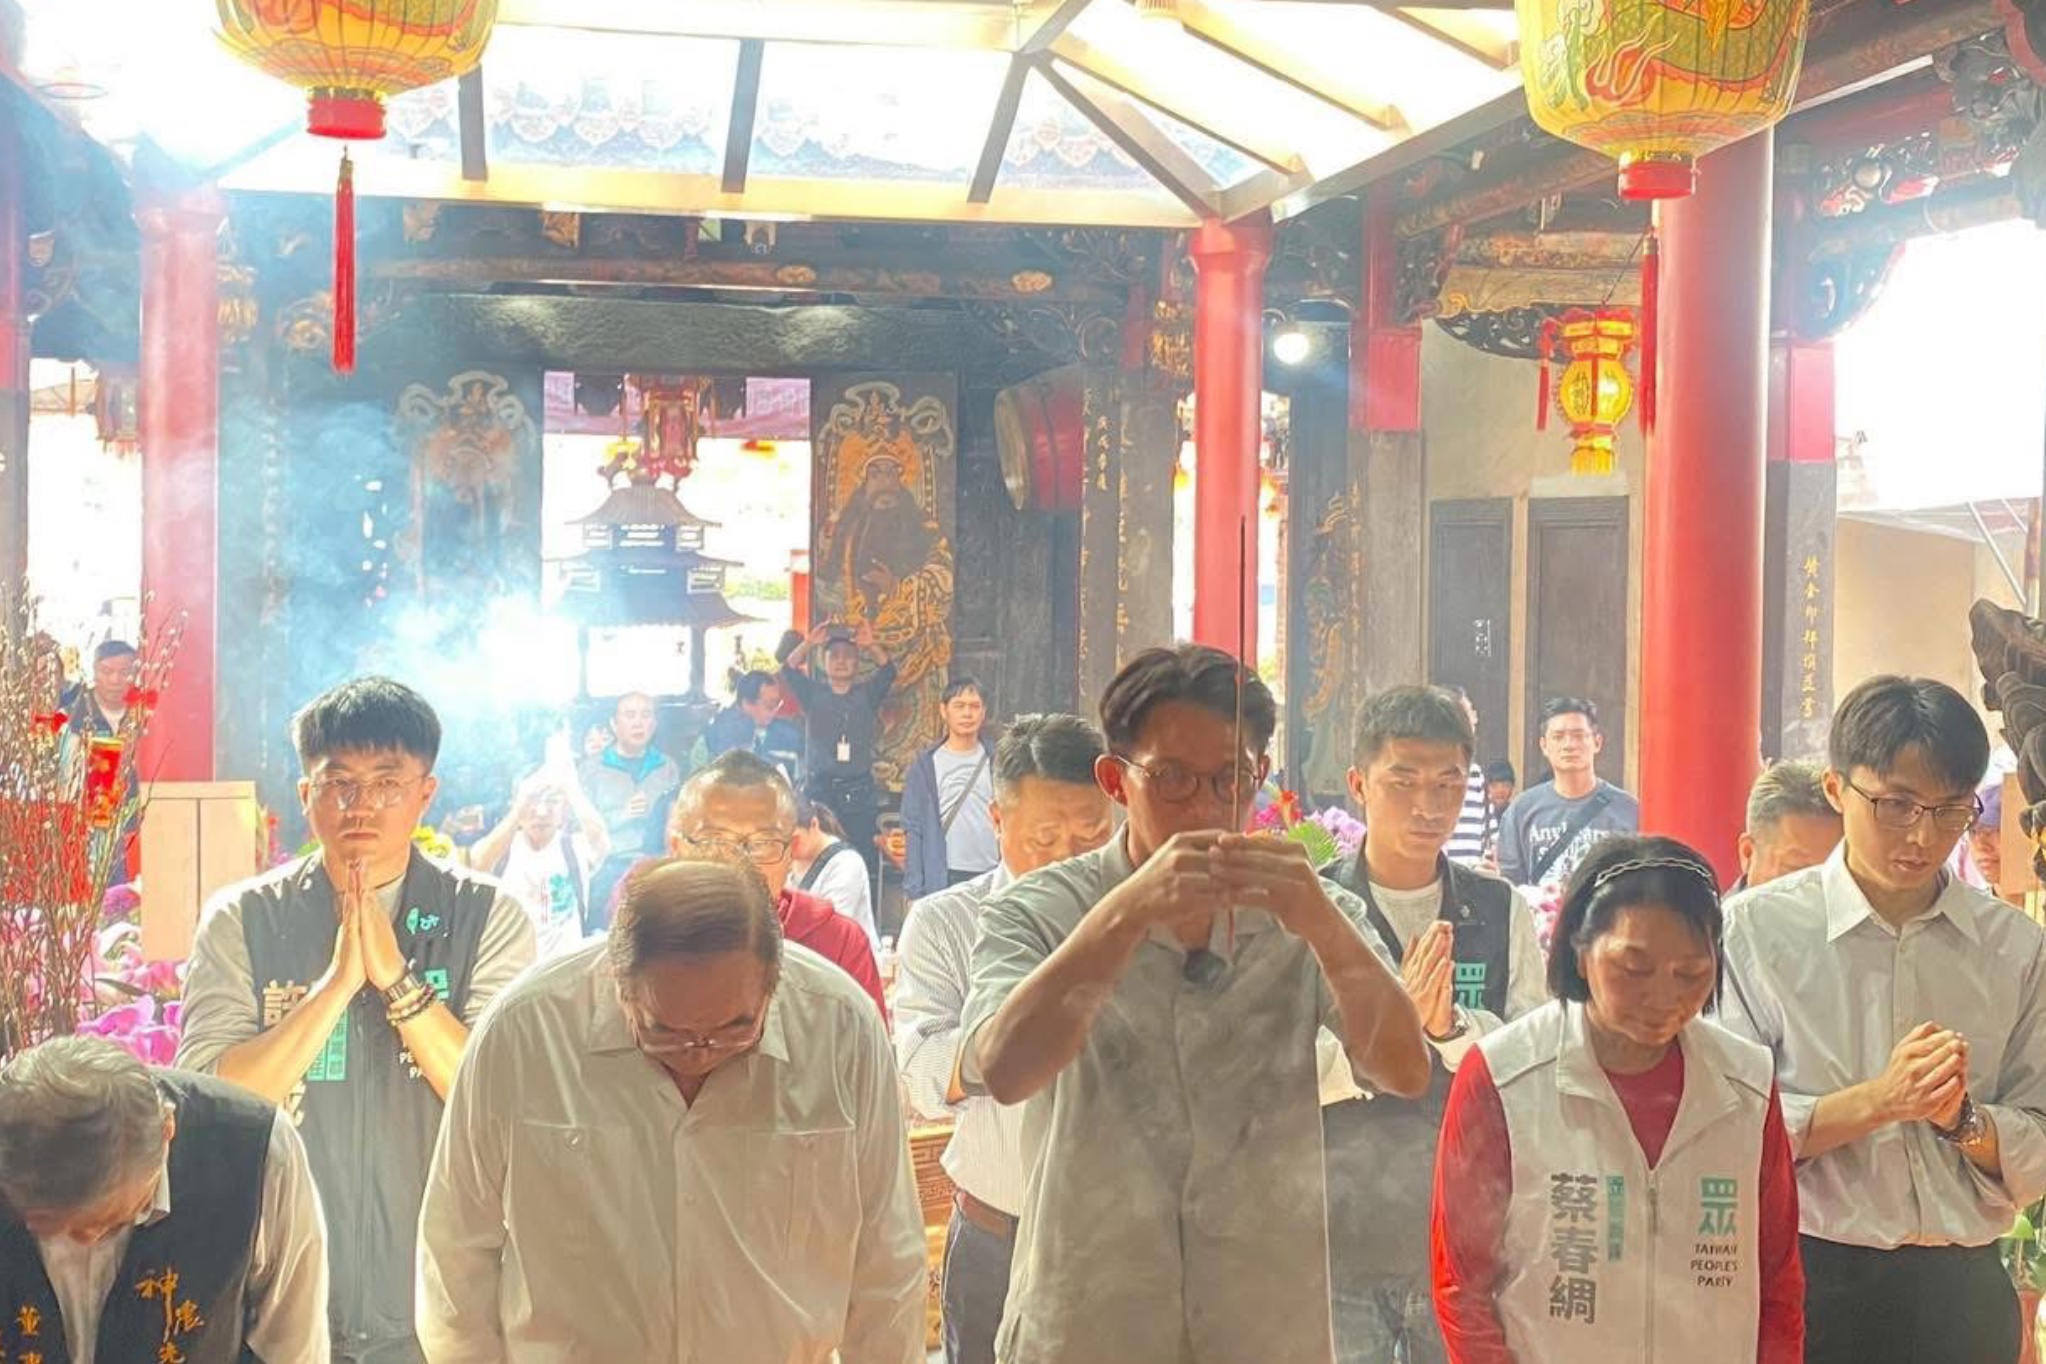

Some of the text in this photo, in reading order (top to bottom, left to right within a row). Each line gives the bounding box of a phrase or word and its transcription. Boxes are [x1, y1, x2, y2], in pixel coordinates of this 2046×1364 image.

[1549, 1172, 1598, 1325] 蔡春綢
[1694, 1243, 1738, 1256] TAIWAN
[1697, 1275, 1734, 1288] PARTY
